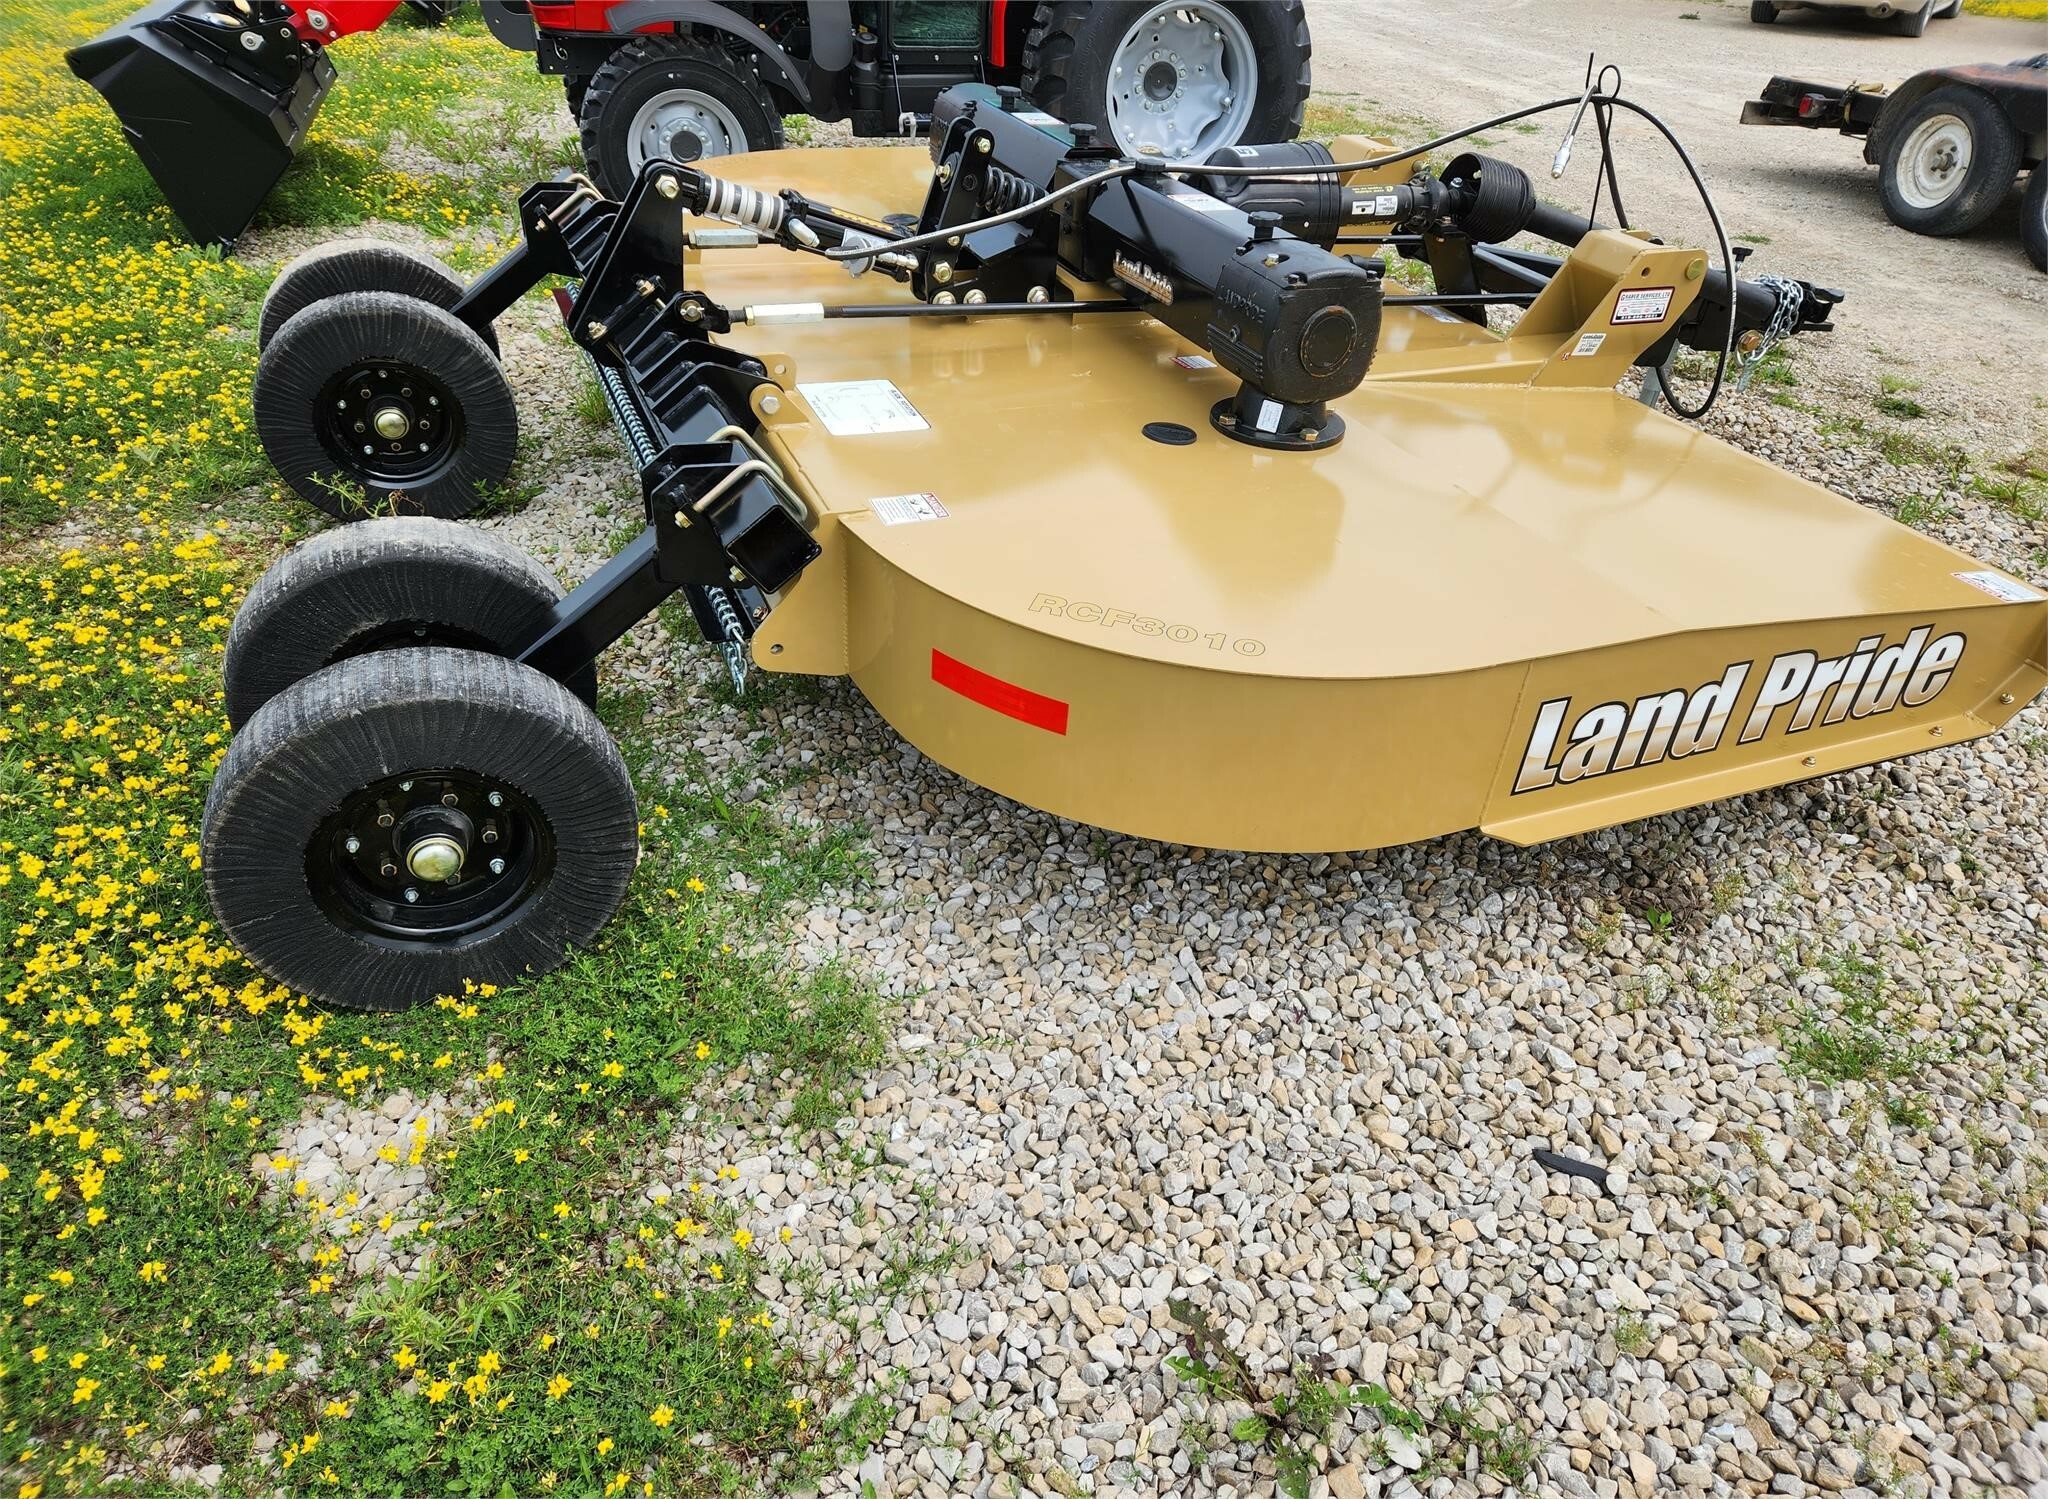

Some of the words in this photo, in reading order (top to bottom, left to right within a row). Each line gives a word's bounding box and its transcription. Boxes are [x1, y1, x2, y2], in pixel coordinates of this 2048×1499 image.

[1113, 249, 1142, 278] Land
[1143, 264, 1174, 299] Pride
[1028, 592, 1266, 657] RCF3010
[1511, 660, 1754, 796] Land
[1737, 623, 1968, 746] Pride
